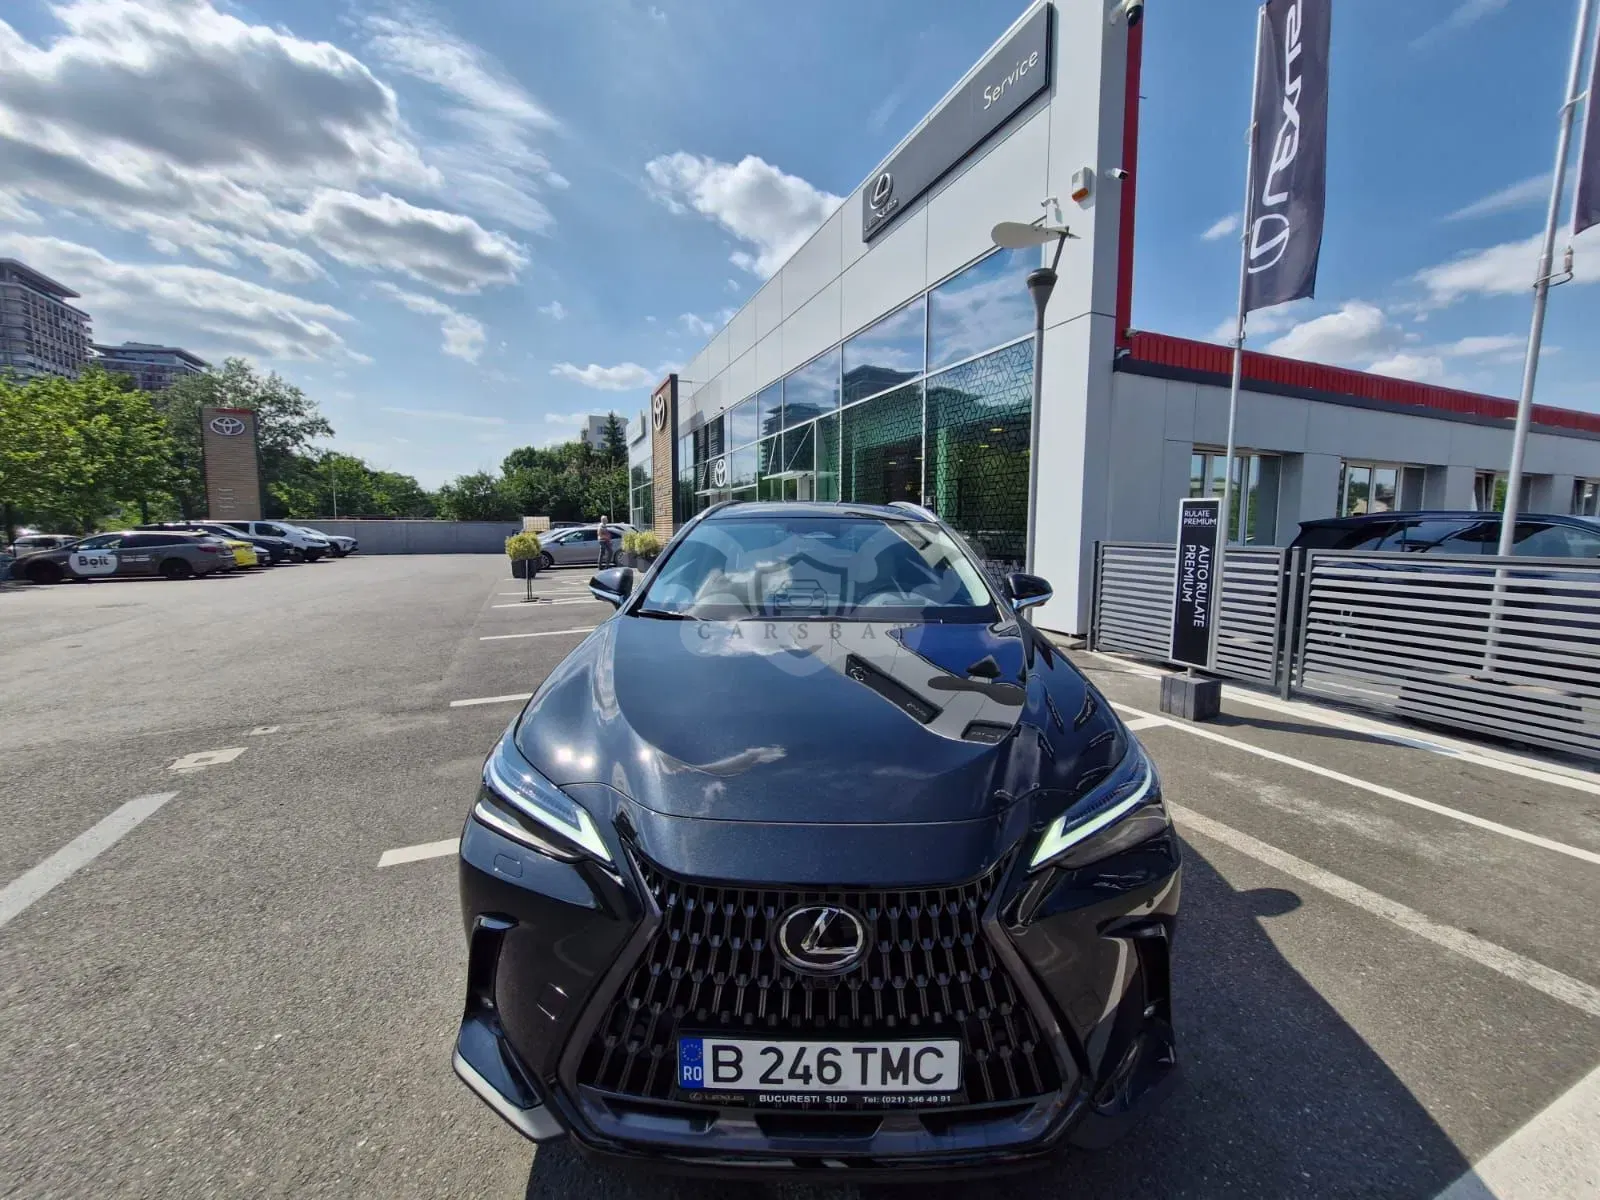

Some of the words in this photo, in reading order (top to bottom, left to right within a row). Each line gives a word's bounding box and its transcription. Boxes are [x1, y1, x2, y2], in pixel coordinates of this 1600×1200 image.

[983, 51, 1038, 110] Service
[1184, 510, 1211, 518] RULATE
[1183, 518, 1217, 526] PREMIUM
[1181, 544, 1197, 602] PREMIUM
[711, 1044, 744, 1083] B
[758, 1046, 843, 1086] 246
[852, 1047, 945, 1086] TMC
[683, 1066, 702, 1081] RO
[759, 1094, 820, 1103] BUCURESTI
[825, 1095, 848, 1104] SUD
